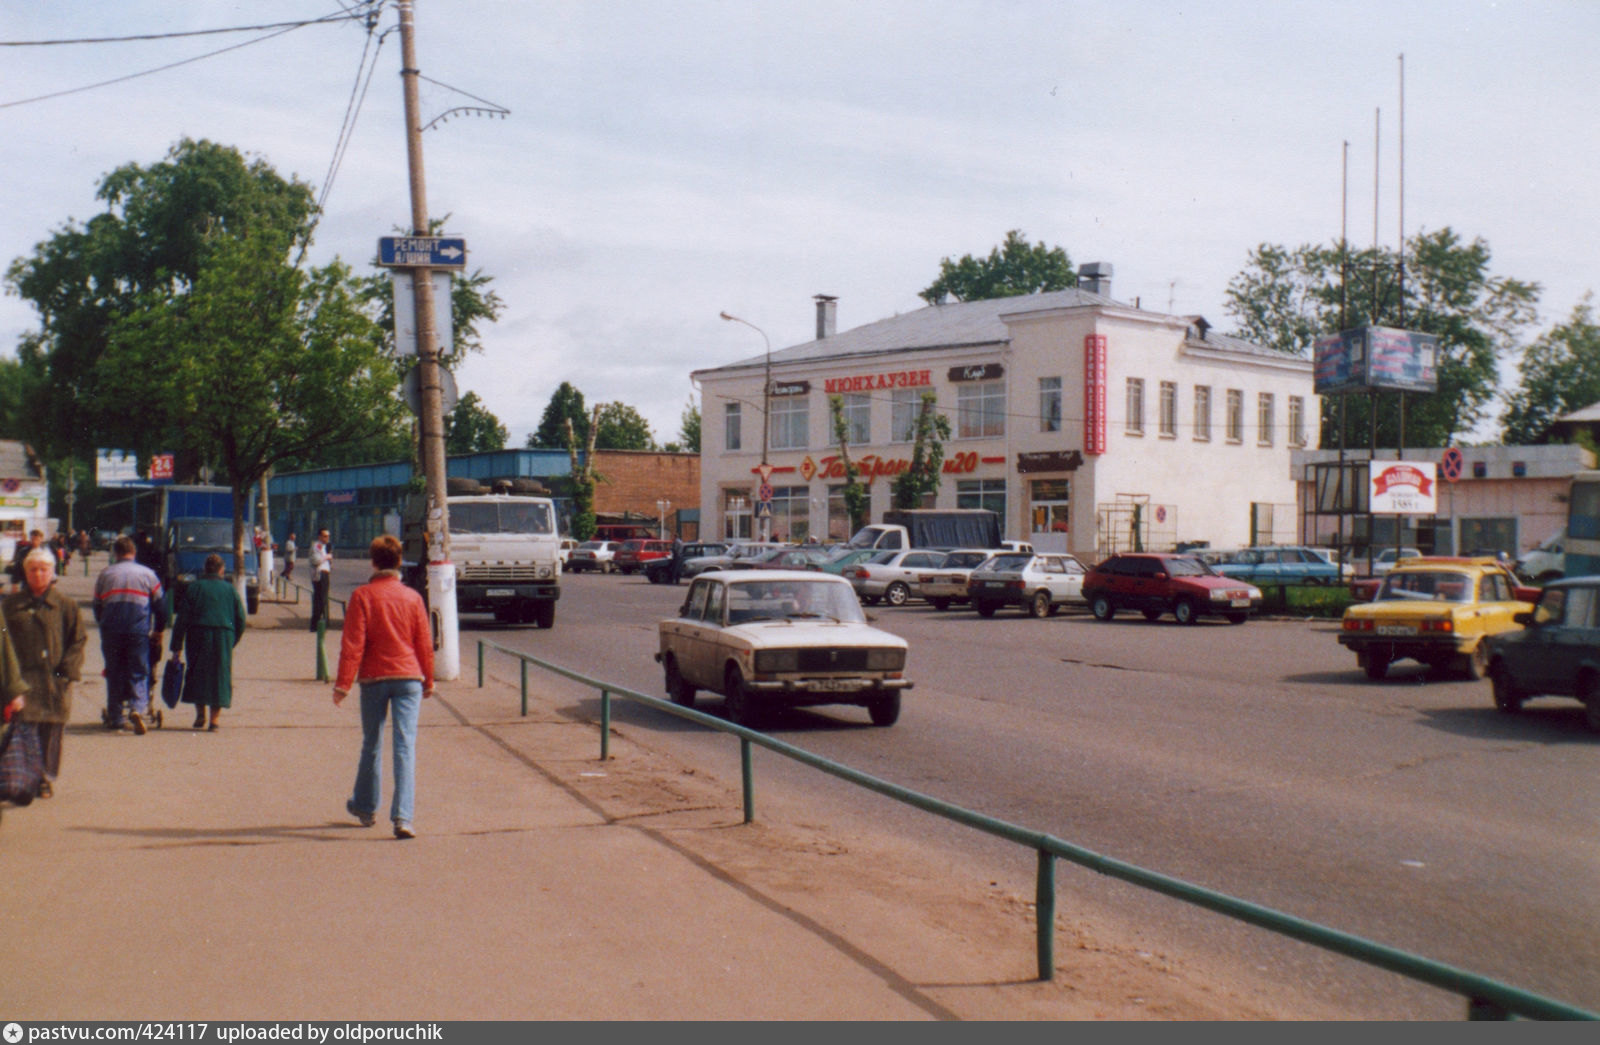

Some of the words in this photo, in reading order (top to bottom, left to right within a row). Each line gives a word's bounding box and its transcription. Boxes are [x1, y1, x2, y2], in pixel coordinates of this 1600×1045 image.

[393, 239, 440, 252] РЕМОНТ
[824, 370, 931, 393] МЮНХАУЗЕН
[154, 459, 171, 471] 24
